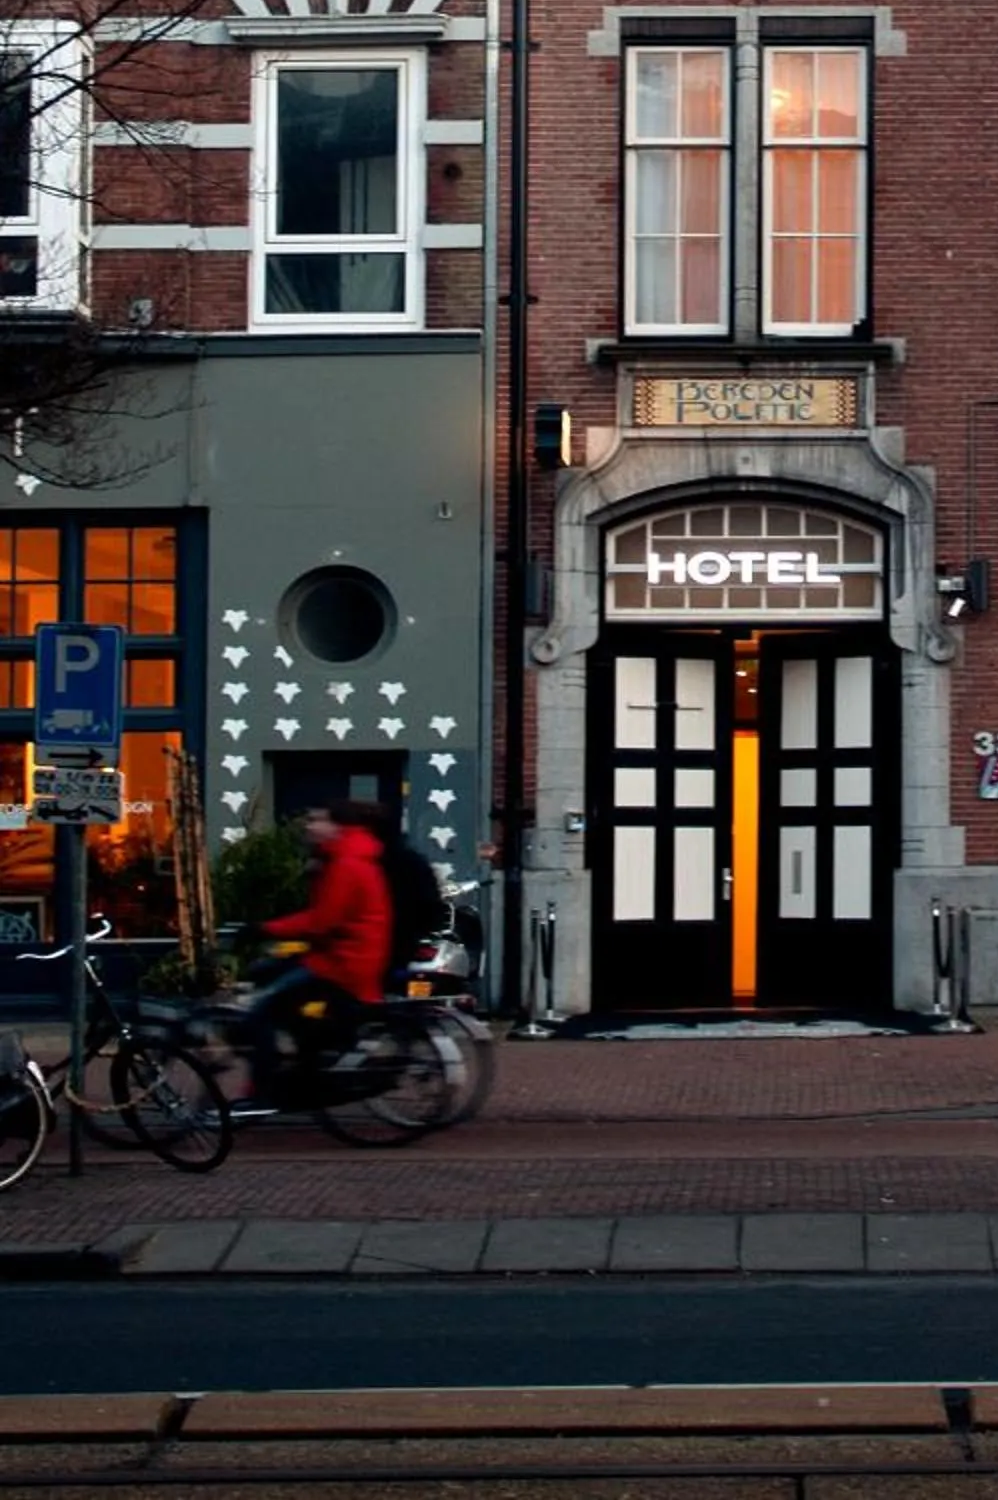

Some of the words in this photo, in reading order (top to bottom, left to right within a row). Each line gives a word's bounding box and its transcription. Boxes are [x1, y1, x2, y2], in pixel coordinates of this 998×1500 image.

[671, 381, 815, 401] BEREDEN
[648, 551, 841, 585] HOTEL
[54, 635, 101, 694] P
